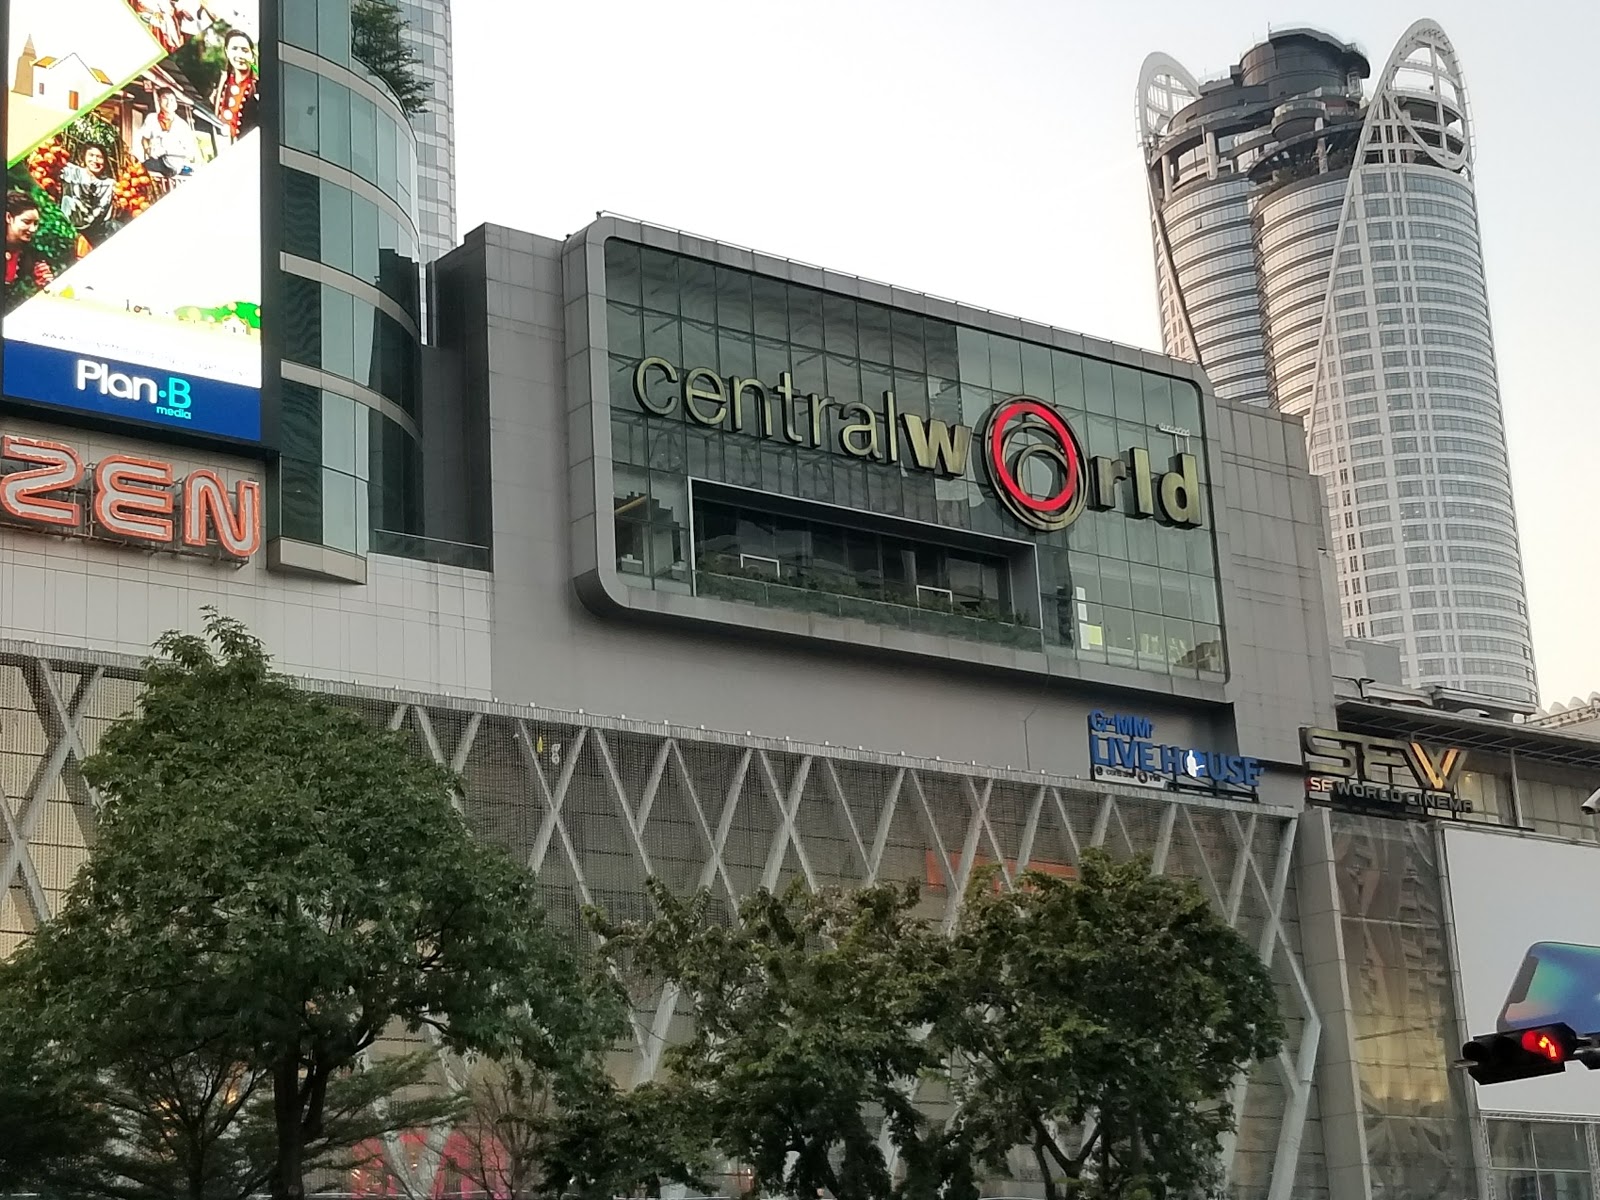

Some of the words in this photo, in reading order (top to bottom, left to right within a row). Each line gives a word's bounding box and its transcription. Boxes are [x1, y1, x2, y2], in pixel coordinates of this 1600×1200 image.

[156, 406, 192, 420] media
[0, 434, 261, 557] ZEN
[1090, 735, 1156, 774] LIVE
[1335, 782, 1403, 804] WORLD
[1405, 791, 1475, 814] CINEMA
